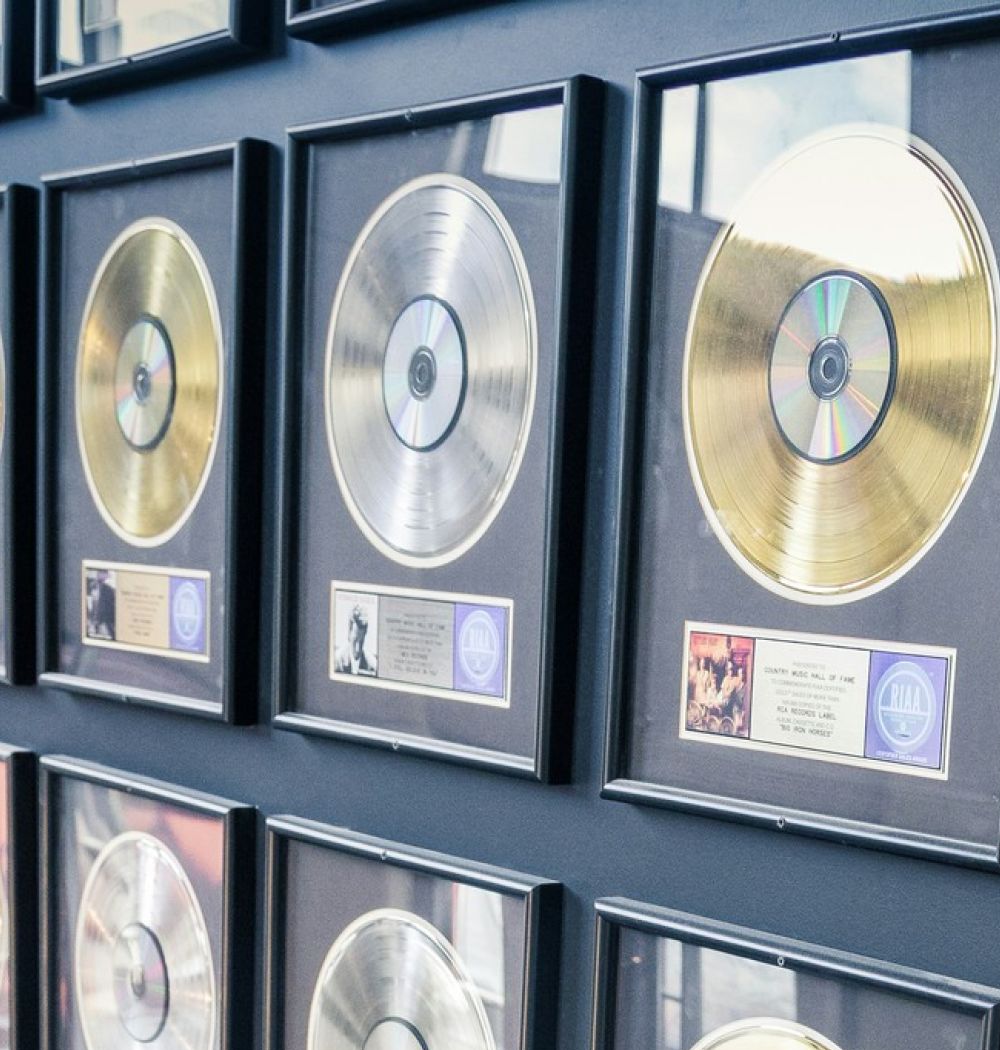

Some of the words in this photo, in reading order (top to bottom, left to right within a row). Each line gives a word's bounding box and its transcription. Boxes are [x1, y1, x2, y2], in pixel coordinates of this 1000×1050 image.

[764, 666, 788, 675] COUNTRY
[792, 669, 808, 677] MUSIC
[840, 675, 855, 683] FAME
[891, 683, 920, 712] RIAA
[790, 707, 816, 717] RECORDS
[818, 711, 836, 720] LABEL
